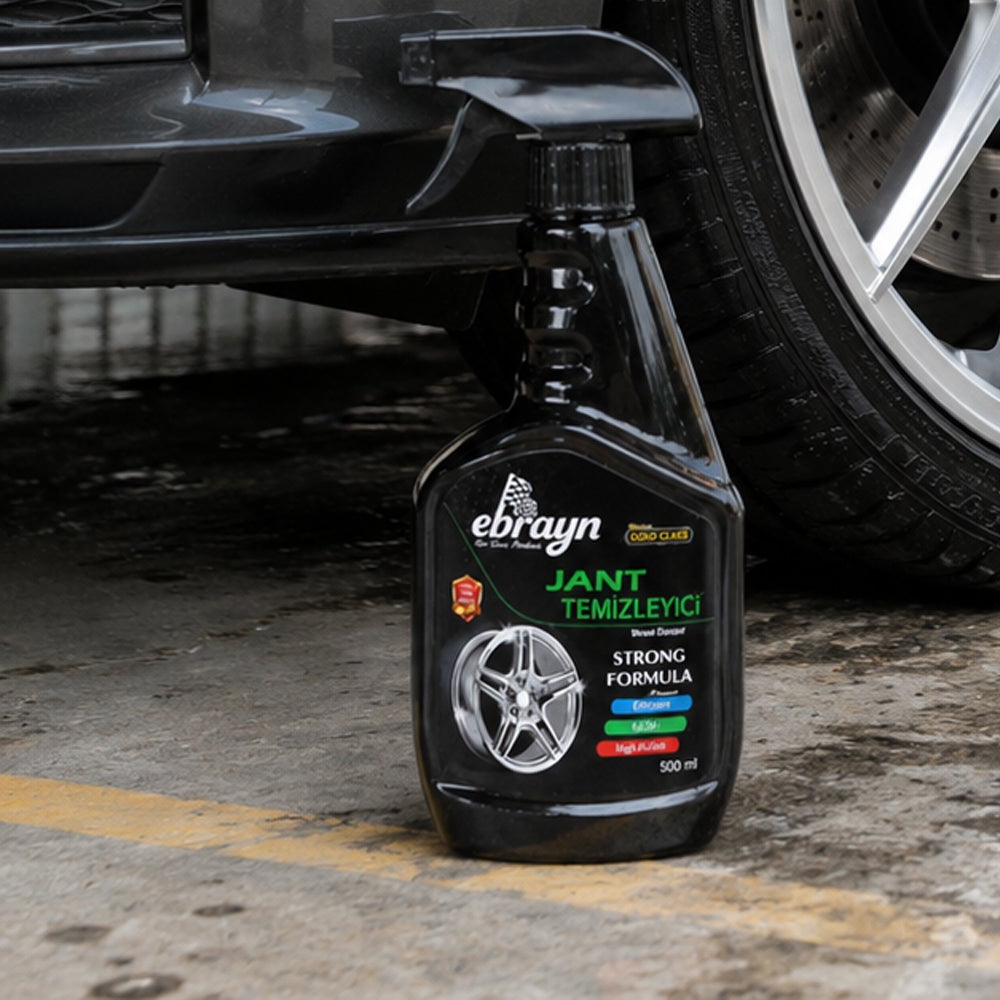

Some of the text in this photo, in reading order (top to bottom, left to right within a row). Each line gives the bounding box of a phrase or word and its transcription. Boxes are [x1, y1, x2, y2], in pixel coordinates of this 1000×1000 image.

[471, 485, 602, 557] ebrayn
[545, 569, 647, 591] JANT
[613, 647, 686, 666] STRONG
[606, 668, 693, 687] FORMULA
[660, 757, 698, 773] 500 ml
